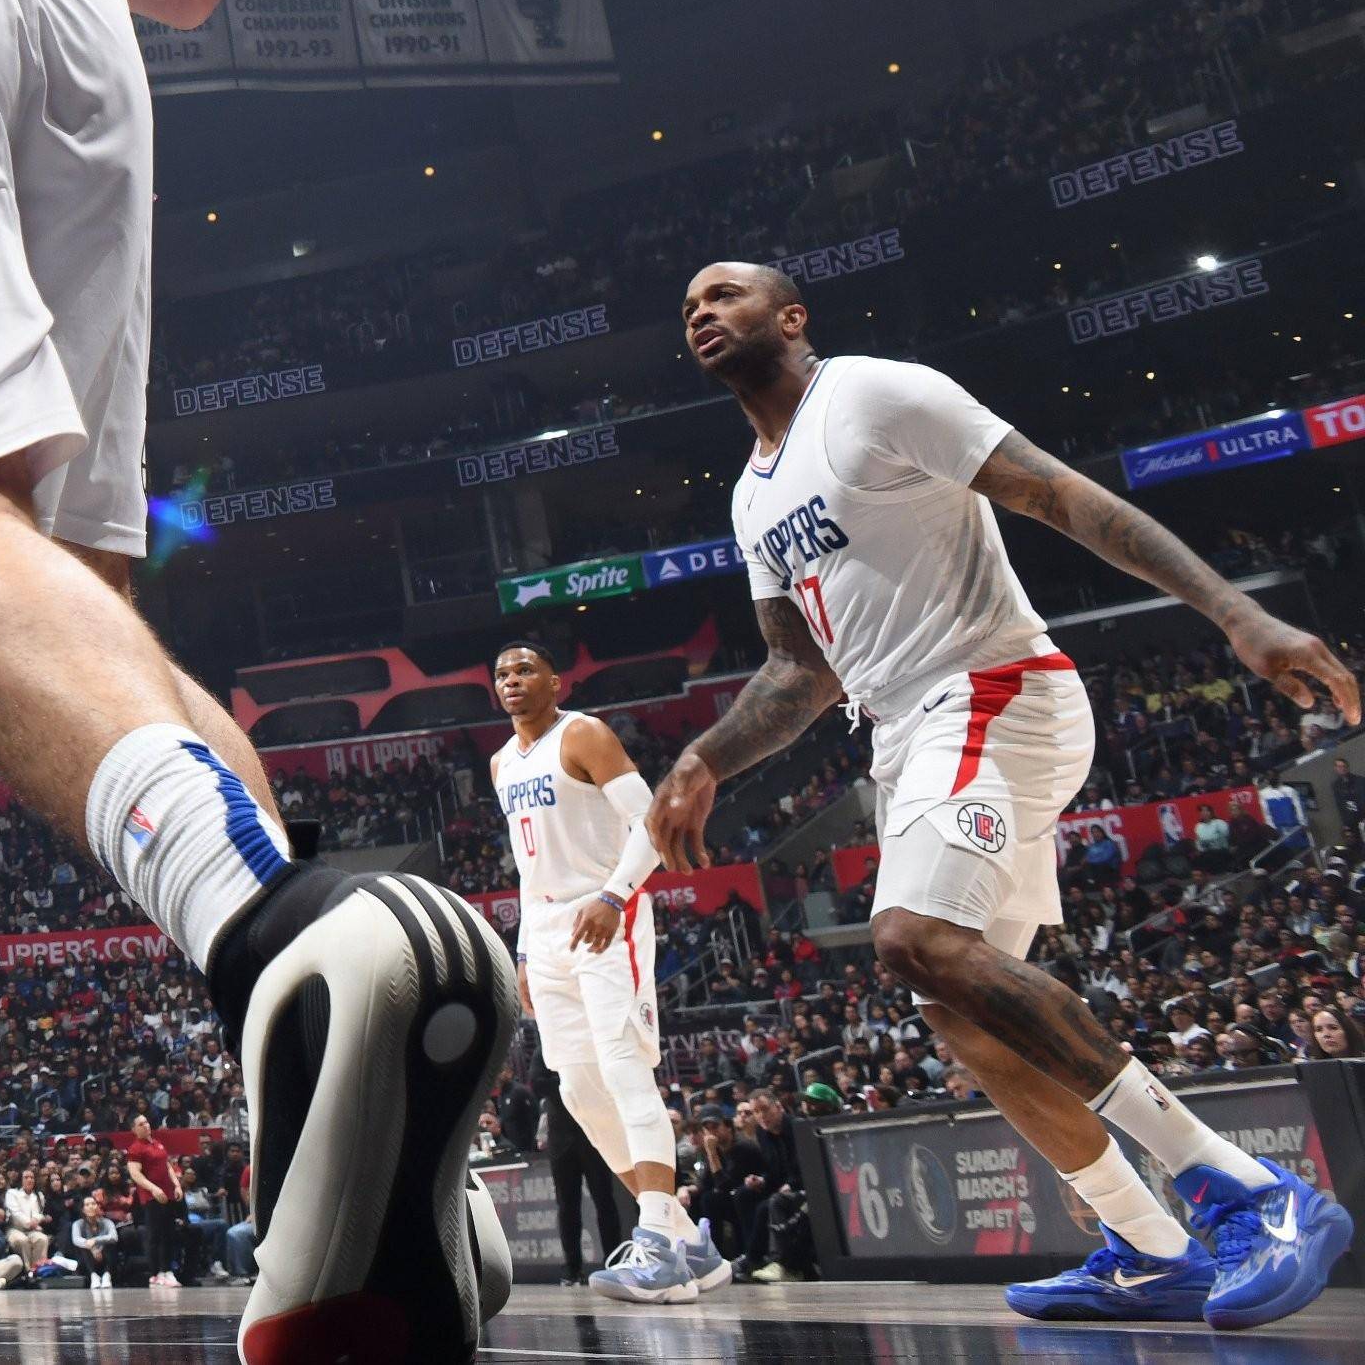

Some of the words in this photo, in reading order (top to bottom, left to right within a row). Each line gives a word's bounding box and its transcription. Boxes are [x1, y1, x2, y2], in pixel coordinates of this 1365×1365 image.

[1048, 119, 1245, 210] DEFENSE
[1070, 258, 1269, 345] DEFENSE
[452, 304, 611, 369] DEFENSE
[174, 364, 326, 417] DEFENSE
[457, 428, 620, 488] DEFENSE
[1220, 426, 1300, 457] ULTRA
[180, 479, 337, 530] DEFENSE
[565, 565, 630, 598] Sprite
[520, 816, 536, 857] 0
[955, 1147, 1019, 1175] SUNDAY
[957, 1177, 1015, 1201] MARCH
[1017, 1174, 1030, 1198] 3
